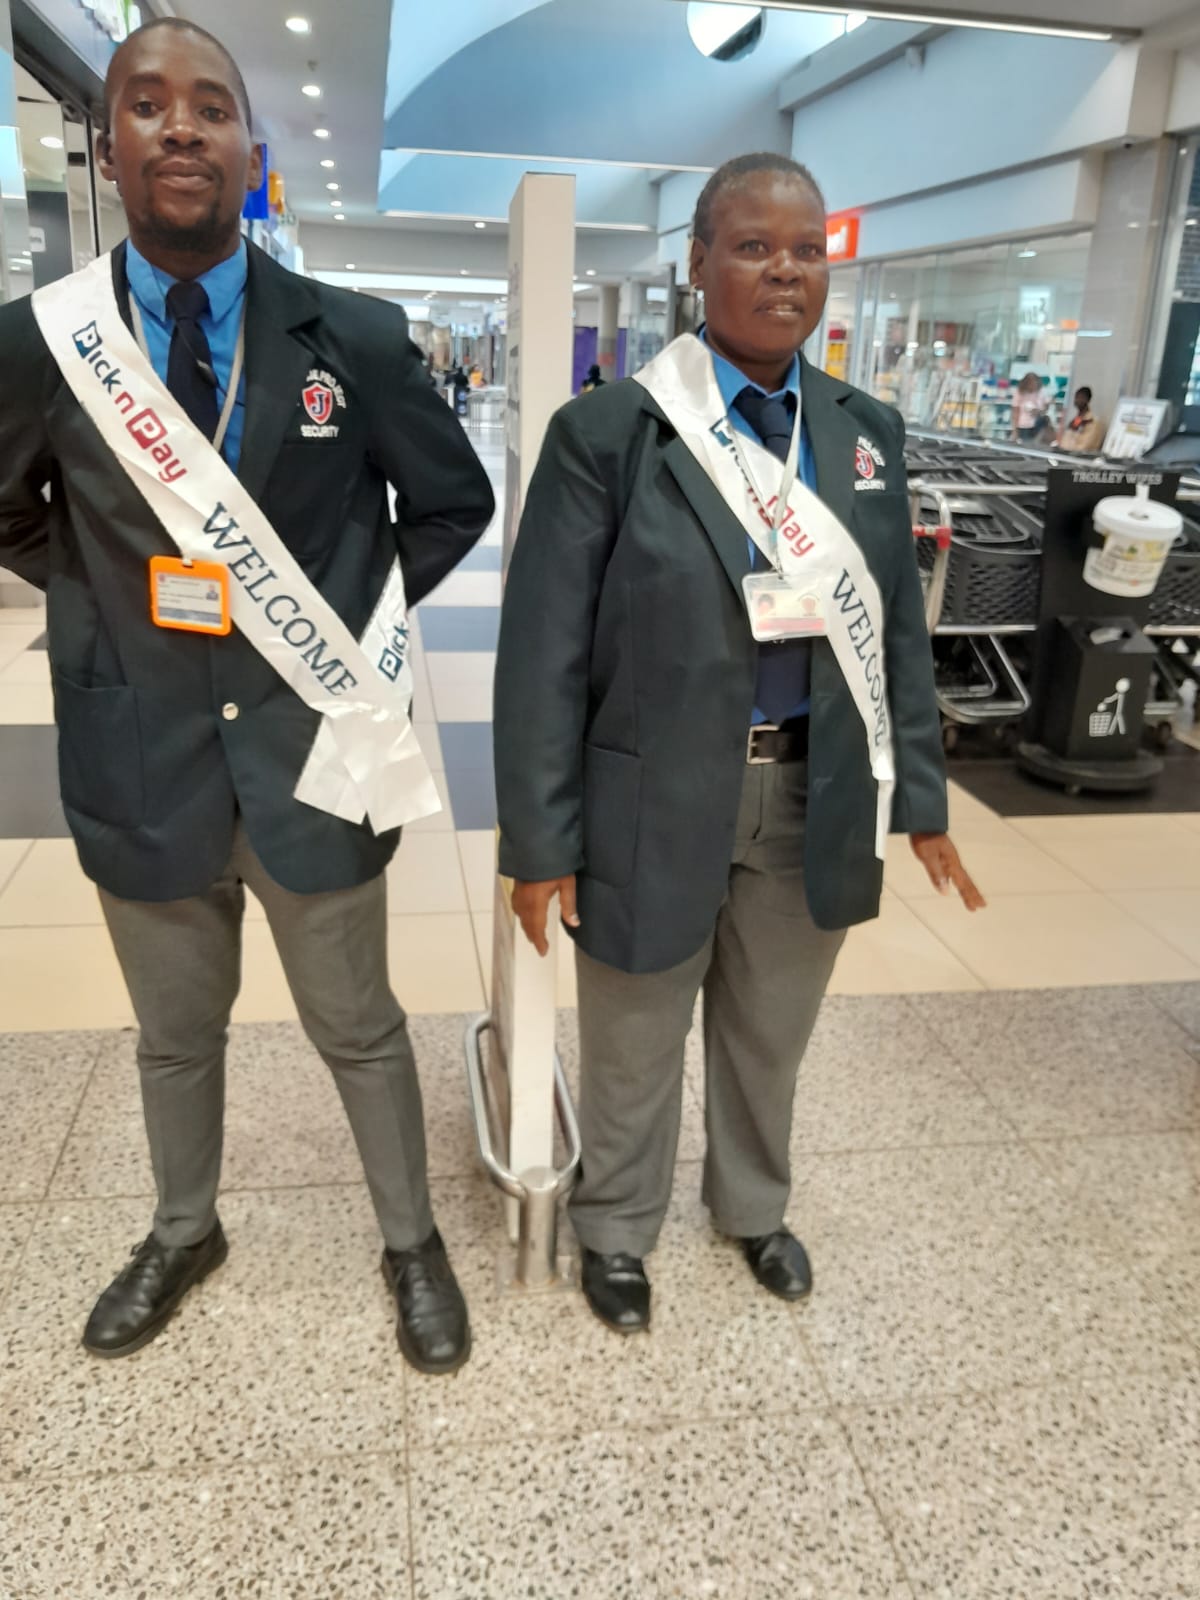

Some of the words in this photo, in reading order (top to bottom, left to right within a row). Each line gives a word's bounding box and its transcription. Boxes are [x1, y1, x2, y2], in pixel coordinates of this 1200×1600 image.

[72, 320, 122, 394] Pick
[114, 390, 136, 415] n
[125, 407, 188, 484] Pay
[300, 424, 339, 438] SECURITY
[1072, 471, 1124, 484] TROLLEY
[203, 501, 358, 696] WELCOME
